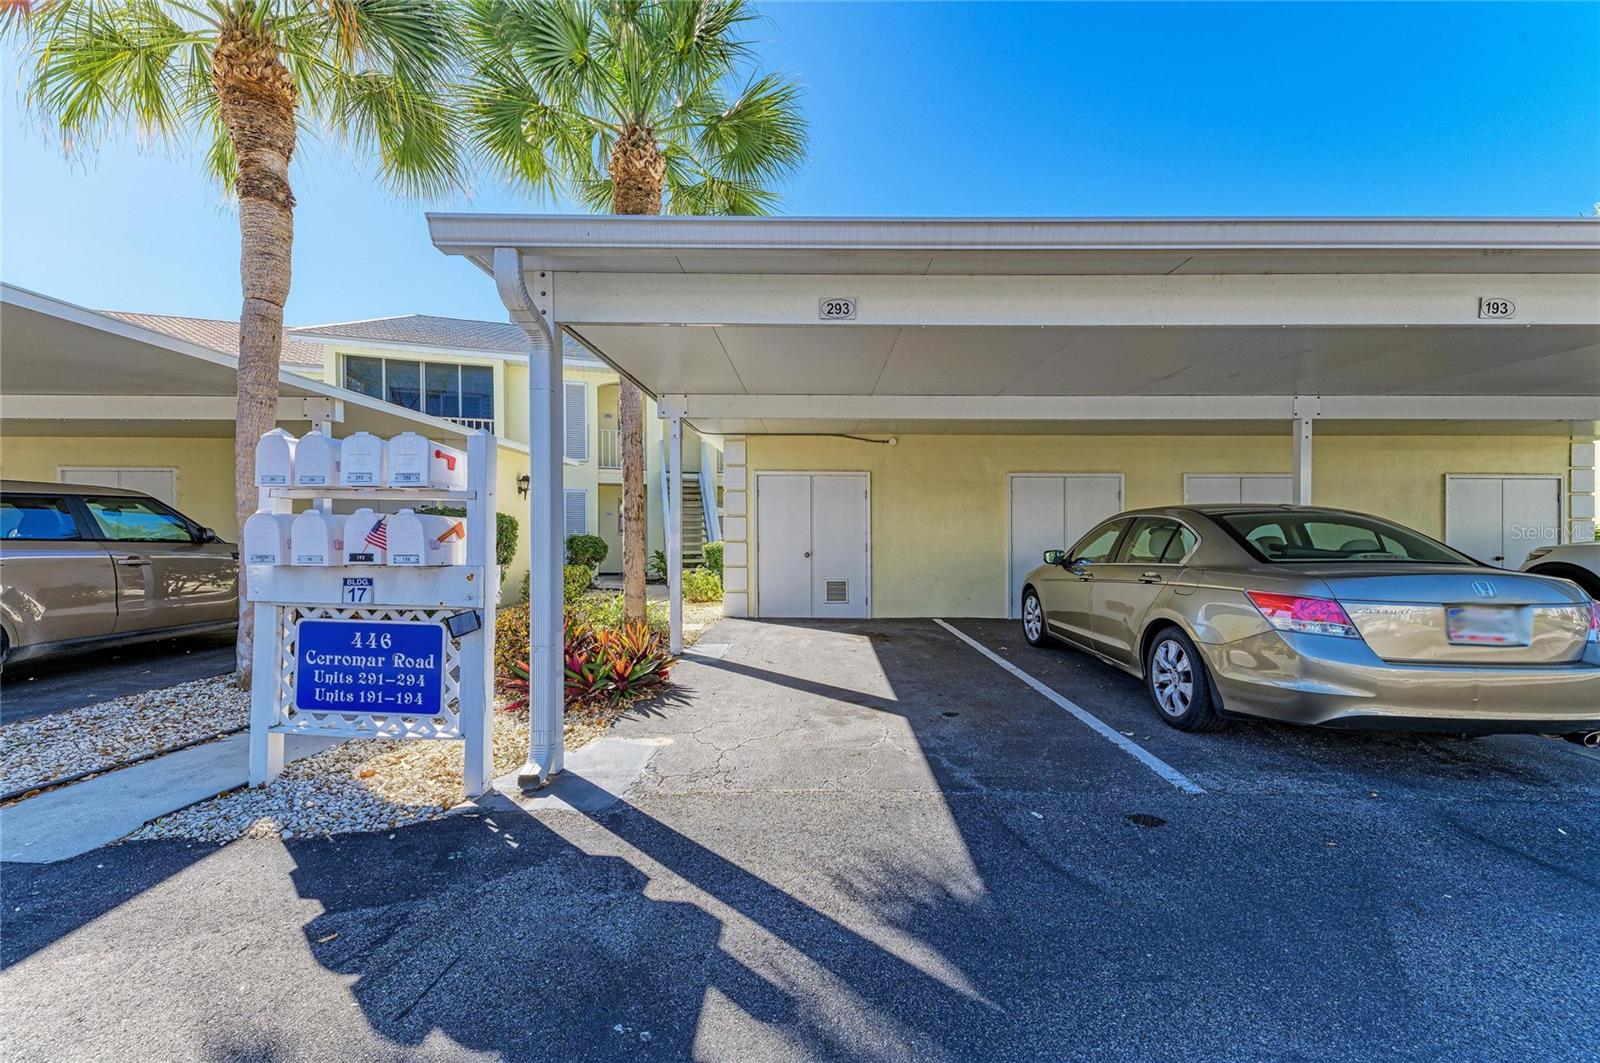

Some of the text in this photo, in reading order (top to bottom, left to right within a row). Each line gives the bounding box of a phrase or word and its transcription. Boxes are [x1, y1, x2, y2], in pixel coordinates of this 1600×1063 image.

[827, 302, 850, 315] 293
[1485, 302, 1508, 314] 193
[348, 587, 367, 602] 17
[350, 632, 392, 649] 446
[305, 650, 435, 669] Cerromar Road
[313, 670, 426, 687] Units 291-294
[314, 688, 424, 705] Units 191-194
